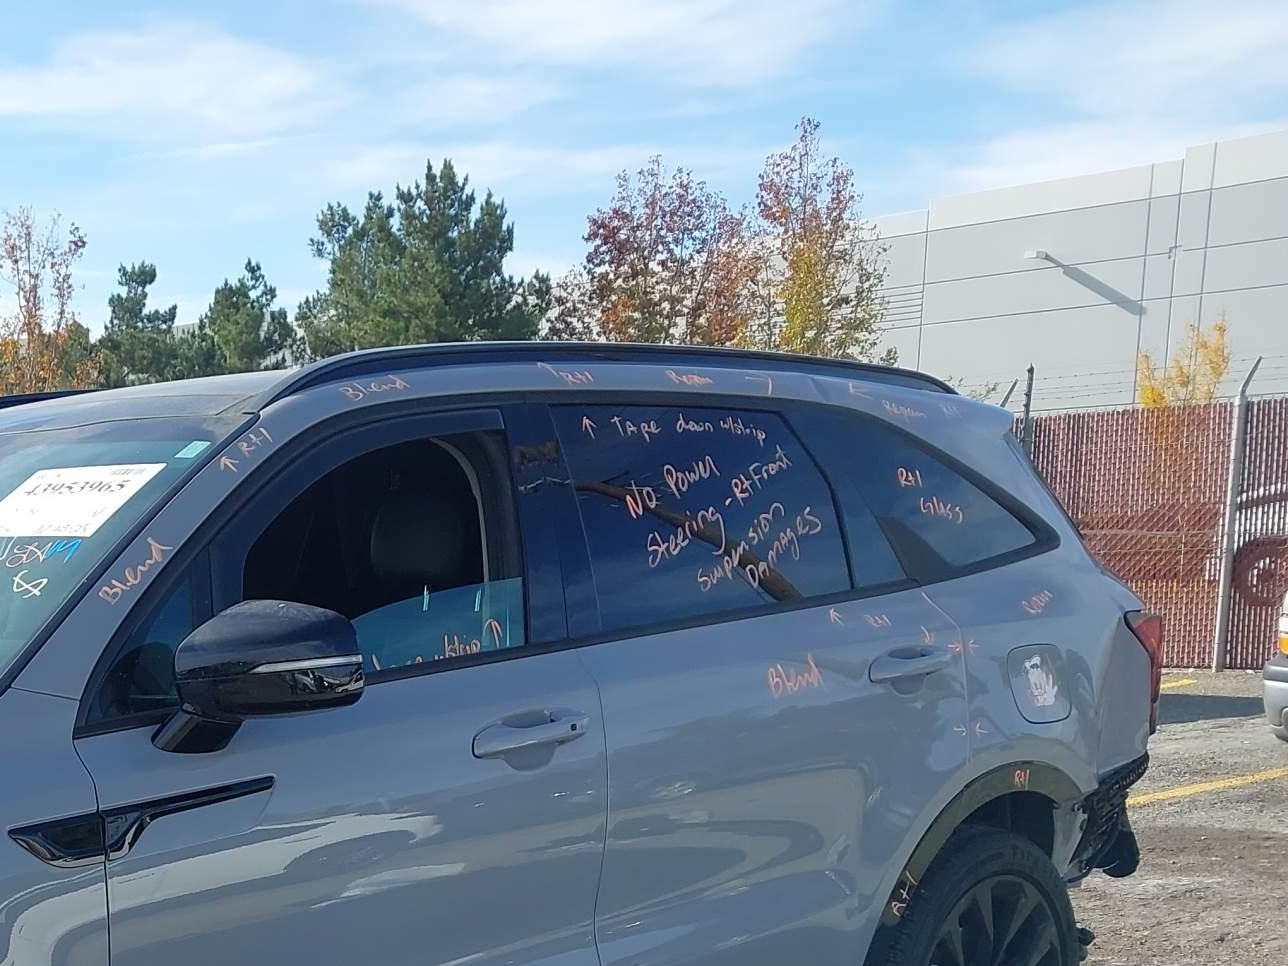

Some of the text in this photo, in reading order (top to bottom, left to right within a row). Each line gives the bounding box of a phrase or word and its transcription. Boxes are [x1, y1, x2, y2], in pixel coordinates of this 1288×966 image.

[337, 374, 410, 401] Blend
[24, 479, 131, 497] 43953965
[647, 506, 727, 568] Steering
[98, 537, 174, 606] Blend
